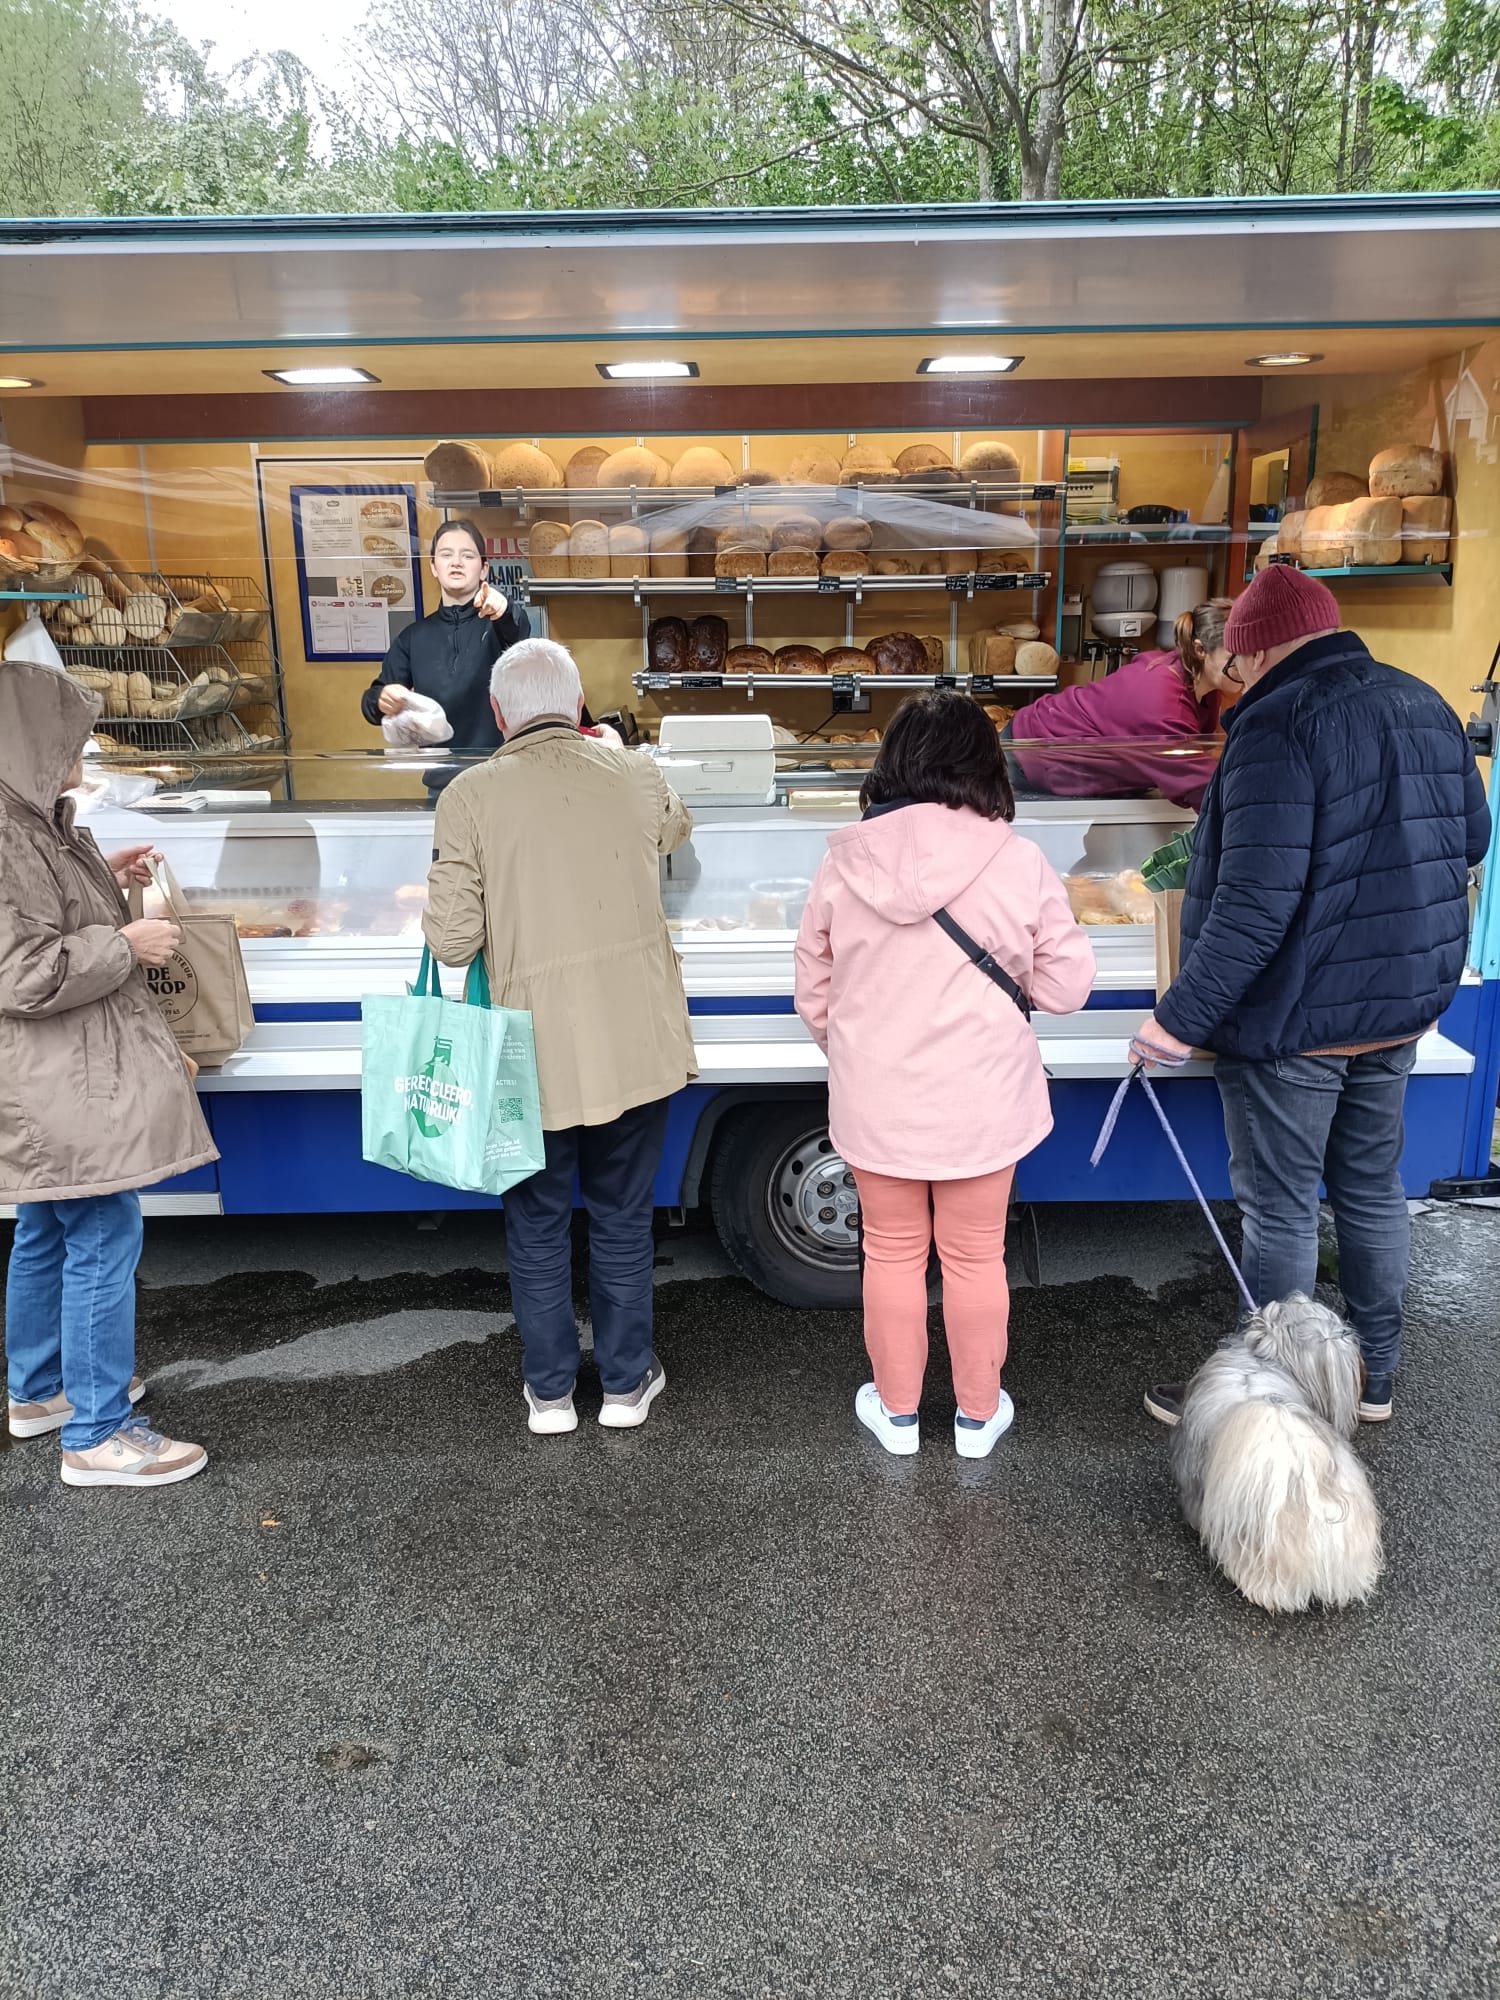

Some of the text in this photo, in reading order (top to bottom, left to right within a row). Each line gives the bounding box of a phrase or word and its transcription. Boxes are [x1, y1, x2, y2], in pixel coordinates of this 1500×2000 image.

[489, 566, 523, 586] AAND
[146, 967, 171, 981] DE
[172, 952, 193, 979] ITEUR
[147, 980, 186, 995] NOP
